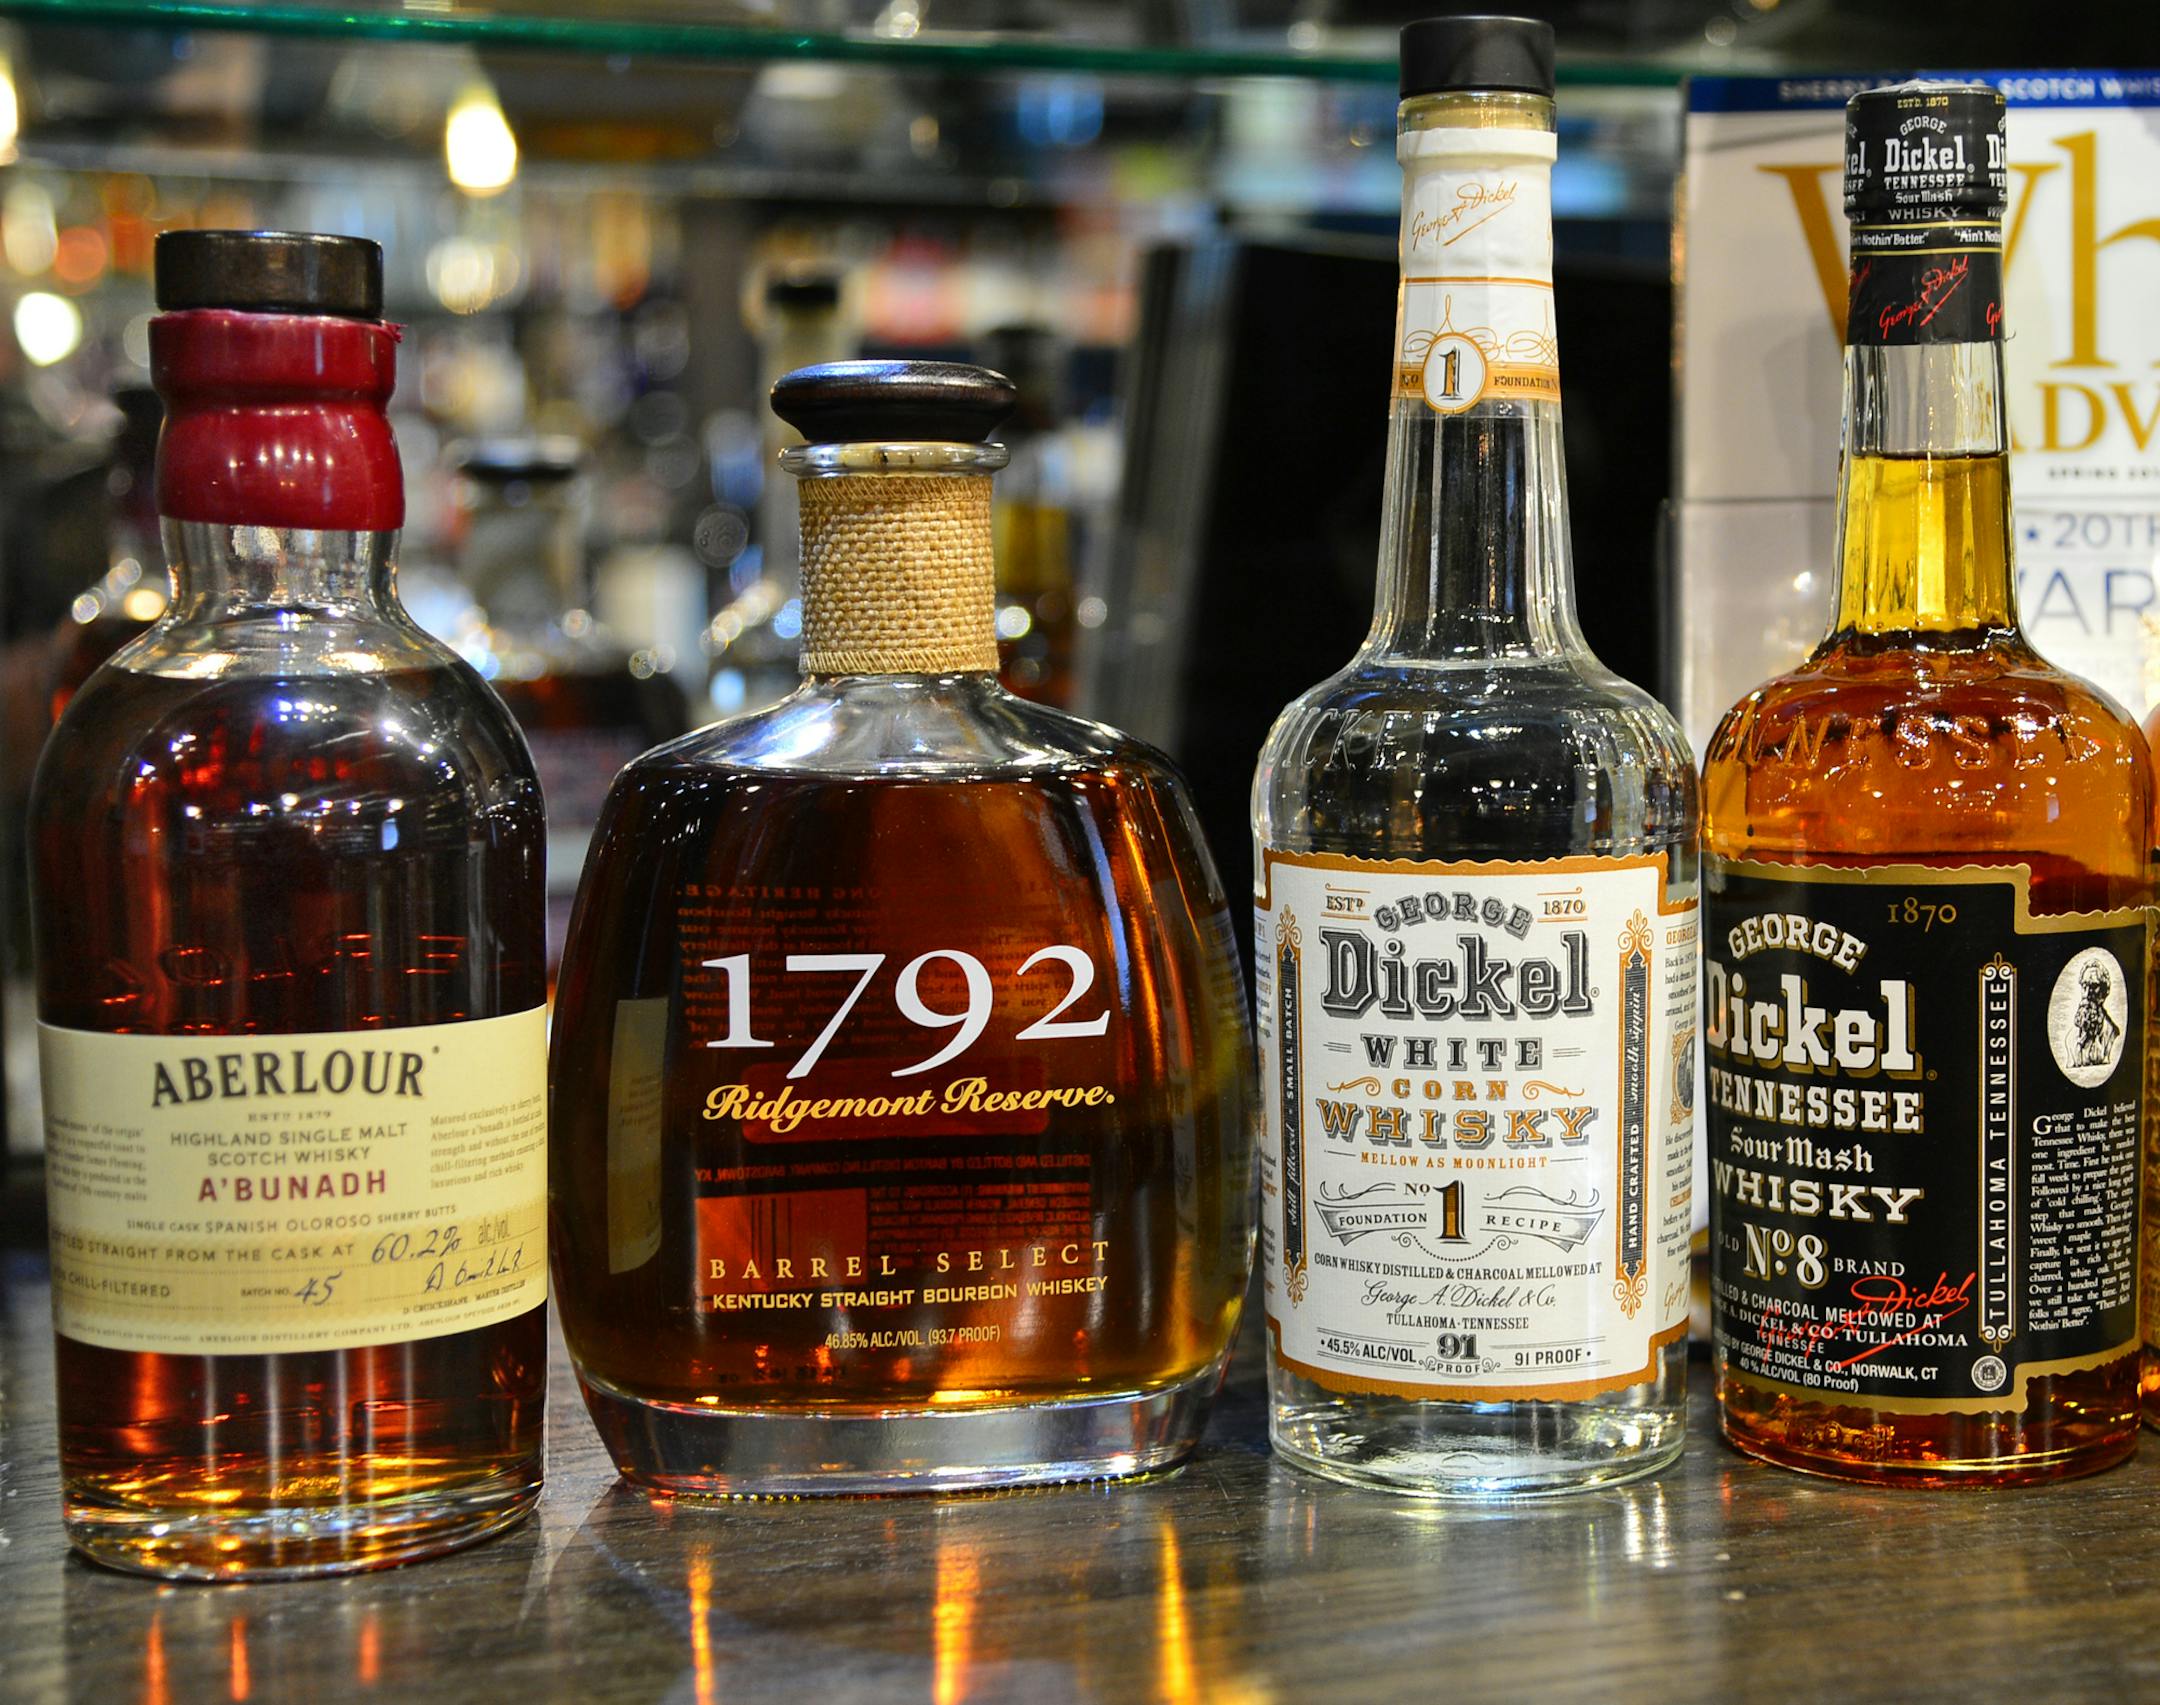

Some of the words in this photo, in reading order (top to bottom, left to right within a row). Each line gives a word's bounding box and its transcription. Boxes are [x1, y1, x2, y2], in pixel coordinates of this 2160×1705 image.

[1926, 96, 1949, 108] 1870
[1900, 116, 1948, 136] GEORGE
[1884, 135, 1966, 173] Dickel
[1884, 173, 1966, 190] TENNESSEE
[1895, 190, 1920, 204] Sour
[1921, 189, 1953, 202] Mash
[1888, 206, 1962, 220] WHISKY
[1439, 349, 1461, 400] 1
[2011, 382, 2160, 454] DV
[1374, 891, 1533, 941] GEORGE
[1543, 899, 1585, 915] 1870
[1887, 896, 1957, 932] 1870
[1728, 913, 1869, 976] GEORGE
[1319, 926, 1594, 1022] Dickel
[702, 944, 1111, 1079] 1792
[1285, 987, 1294, 1043] BATCH
[1706, 958, 1923, 1080] Dickel
[1360, 1033, 1543, 1071] WHITE
[1989, 983, 2007, 1140] TENNESSEE
[151, 1048, 424, 1108] ABERLOUR
[1286, 1045, 1295, 1100] SMALL
[1627, 1045, 1640, 1104] smooth
[1391, 1078, 1509, 1101] CORN
[1709, 1064, 1924, 1134] TENNESSEE
[703, 1083, 936, 1134] Ridgemont
[1316, 1098, 1599, 1150] WHISKY
[171, 1132, 271, 1146] HIGHLAND
[279, 1128, 351, 1145] SINGLE
[359, 1123, 407, 1140] MALT
[1730, 1126, 1784, 1163] Sour
[1785, 1136, 1875, 1174] Mash
[2032, 1136, 2074, 1147] Tennessee
[208, 1152, 287, 1167] SCOTCH
[294, 1147, 371, 1163] WHISKY
[1285, 1123, 1301, 1186] filtered
[1361, 1151, 1418, 1167] MELLOW
[1426, 1158, 1445, 1168] AS
[1454, 1156, 1548, 1169] MOONLIGHT
[1628, 1123, 1640, 1197] CRAFTED
[2031, 1151, 2049, 1159] one
[198, 1169, 386, 1202] A'BUNADH
[1713, 1158, 1925, 1224] WHISKY
[2031, 1183, 2069, 1196] Followed
[127, 1220, 165, 1232] SINGLE
[169, 1222, 200, 1232] CASK
[205, 1219, 278, 1234] SPANISH
[286, 1214, 372, 1232] OLOROSO
[377, 1210, 420, 1224] SHERRY
[425, 1204, 457, 1218] BUTTS
[1339, 1213, 1428, 1226] FOUNDATION
[1433, 1179, 1471, 1245] 1
[1486, 1215, 1562, 1232] RECIPE
[1628, 1202, 1638, 1248] HAND
[2030, 1212, 2049, 1223] step
[2030, 1222, 2063, 1233] Whisky
[88, 1240, 157, 1259] STRAIGHT
[166, 1248, 216, 1262] FROM
[225, 1248, 261, 1261] THE
[271, 1244, 321, 1261] CASK
[333, 1244, 354, 1256] AT
[371, 1225, 464, 1264] 60.2%
[1989, 1157, 2006, 1320] TULLAHOMA
[710, 1255, 896, 1279] BARREL
[937, 1241, 1109, 1272] SELECT
[1314, 1253, 1338, 1268] CORN
[1339, 1257, 1381, 1274] WHISKY
[1383, 1263, 1444, 1279] DISTILLED
[1446, 1268, 1455, 1279] &
[1457, 1267, 1524, 1280] CHARCOAL
[1526, 1264, 1587, 1280] MELLOWED
[1588, 1262, 1602, 1274] AT
[1833, 1257, 1905, 1277] BRAND
[2029, 1261, 2061, 1272] capture
[68, 1271, 171, 1297] CHILL-FILTERED
[241, 1287, 273, 1297] BATCH
[293, 1271, 342, 1306] 45
[713, 1293, 813, 1309] KENTUCKY
[820, 1290, 915, 1307] STRAIGHT
[923, 1284, 1018, 1304] BOURBON
[1026, 1276, 1108, 1297] WHISKEY
[1361, 1279, 1417, 1314] George
[1450, 1283, 1512, 1308] Dickel
[1519, 1290, 1535, 1307] &
[1851, 1271, 1976, 1315] Dickel
[2029, 1284, 2053, 1294] Over
[1387, 1313, 1455, 1329] TULLAHOMA
[1462, 1317, 1529, 1330] TENNESSEE
[1741, 1291, 1749, 1305] &
[1751, 1292, 1819, 1321] CHARCOAL
[1825, 1306, 1917, 1328] MELLOWED
[1923, 1313, 1944, 1329] AT
[2029, 1308, 2050, 1319] folks
[825, 1332, 868, 1349] 46.85%
[870, 1328, 925, 1347] ALC./VOL.
[928, 1327, 954, 1345] (93.7
[958, 1325, 1000, 1345] PROOF)
[1739, 1308, 1788, 1334] DICKEL
[1791, 1322, 1803, 1335] &
[1842, 1328, 1968, 1347] TULLAHOMA
[1755, 1328, 1825, 1354] TENNESSEE
[1327, 1337, 1360, 1357] 45.5%
[1363, 1344, 1416, 1363] ALC/VOL
[1437, 1333, 1480, 1360] 91
[1515, 1351, 1530, 1367] 91
[1535, 1348, 1583, 1366] PROOF
[1740, 1341, 1774, 1362] GEORGE
[1774, 1350, 1811, 1370] DICKEL
[1813, 1360, 1822, 1372] &
[1851, 1363, 1918, 1380] NORWALK,
[1921, 1367, 1939, 1381] CT
[1437, 1363, 1480, 1374] PROOF
[1760, 1363, 1801, 1384] ALC/VOL
[1803, 1372, 1821, 1387] (80
[1824, 1376, 1859, 1393] Proof)
